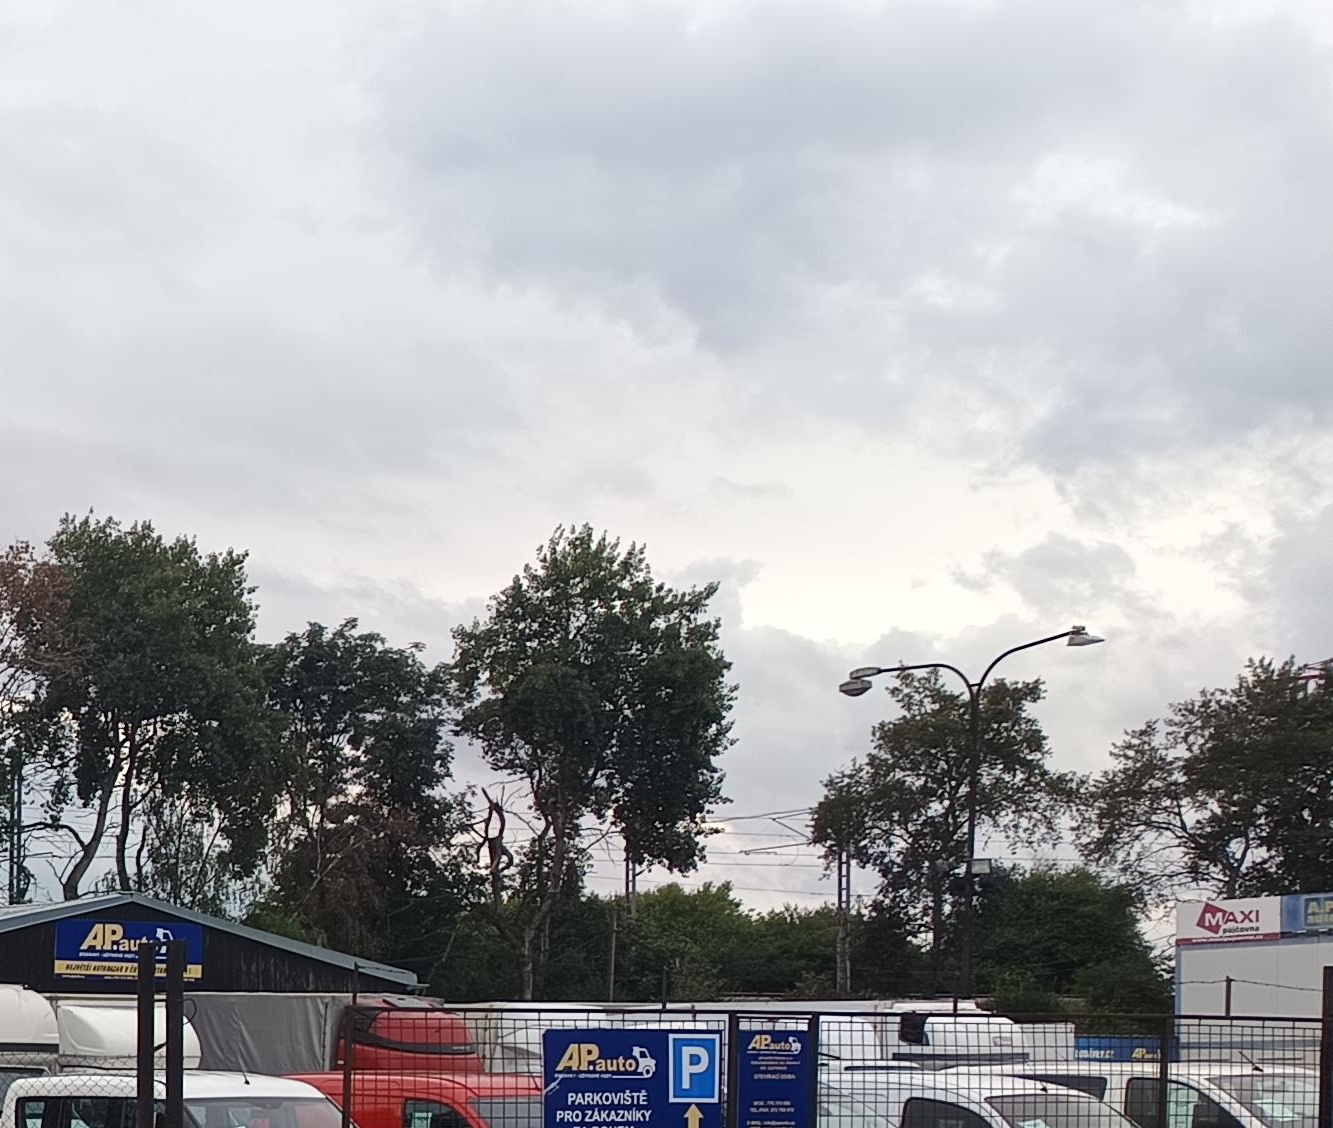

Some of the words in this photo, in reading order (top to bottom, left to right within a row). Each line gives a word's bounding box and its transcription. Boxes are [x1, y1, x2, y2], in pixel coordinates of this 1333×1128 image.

[1204, 909, 1260, 927] MAXI
[79, 923, 154, 951] AP.aut
[555, 1043, 636, 1072] AP.auto
[681, 1046, 710, 1089] P
[567, 1089, 648, 1105] PARKOVIŠTĚ
[556, 1110, 582, 1122] PRO
[584, 1107, 652, 1122] ZÁKAZNÍKY
